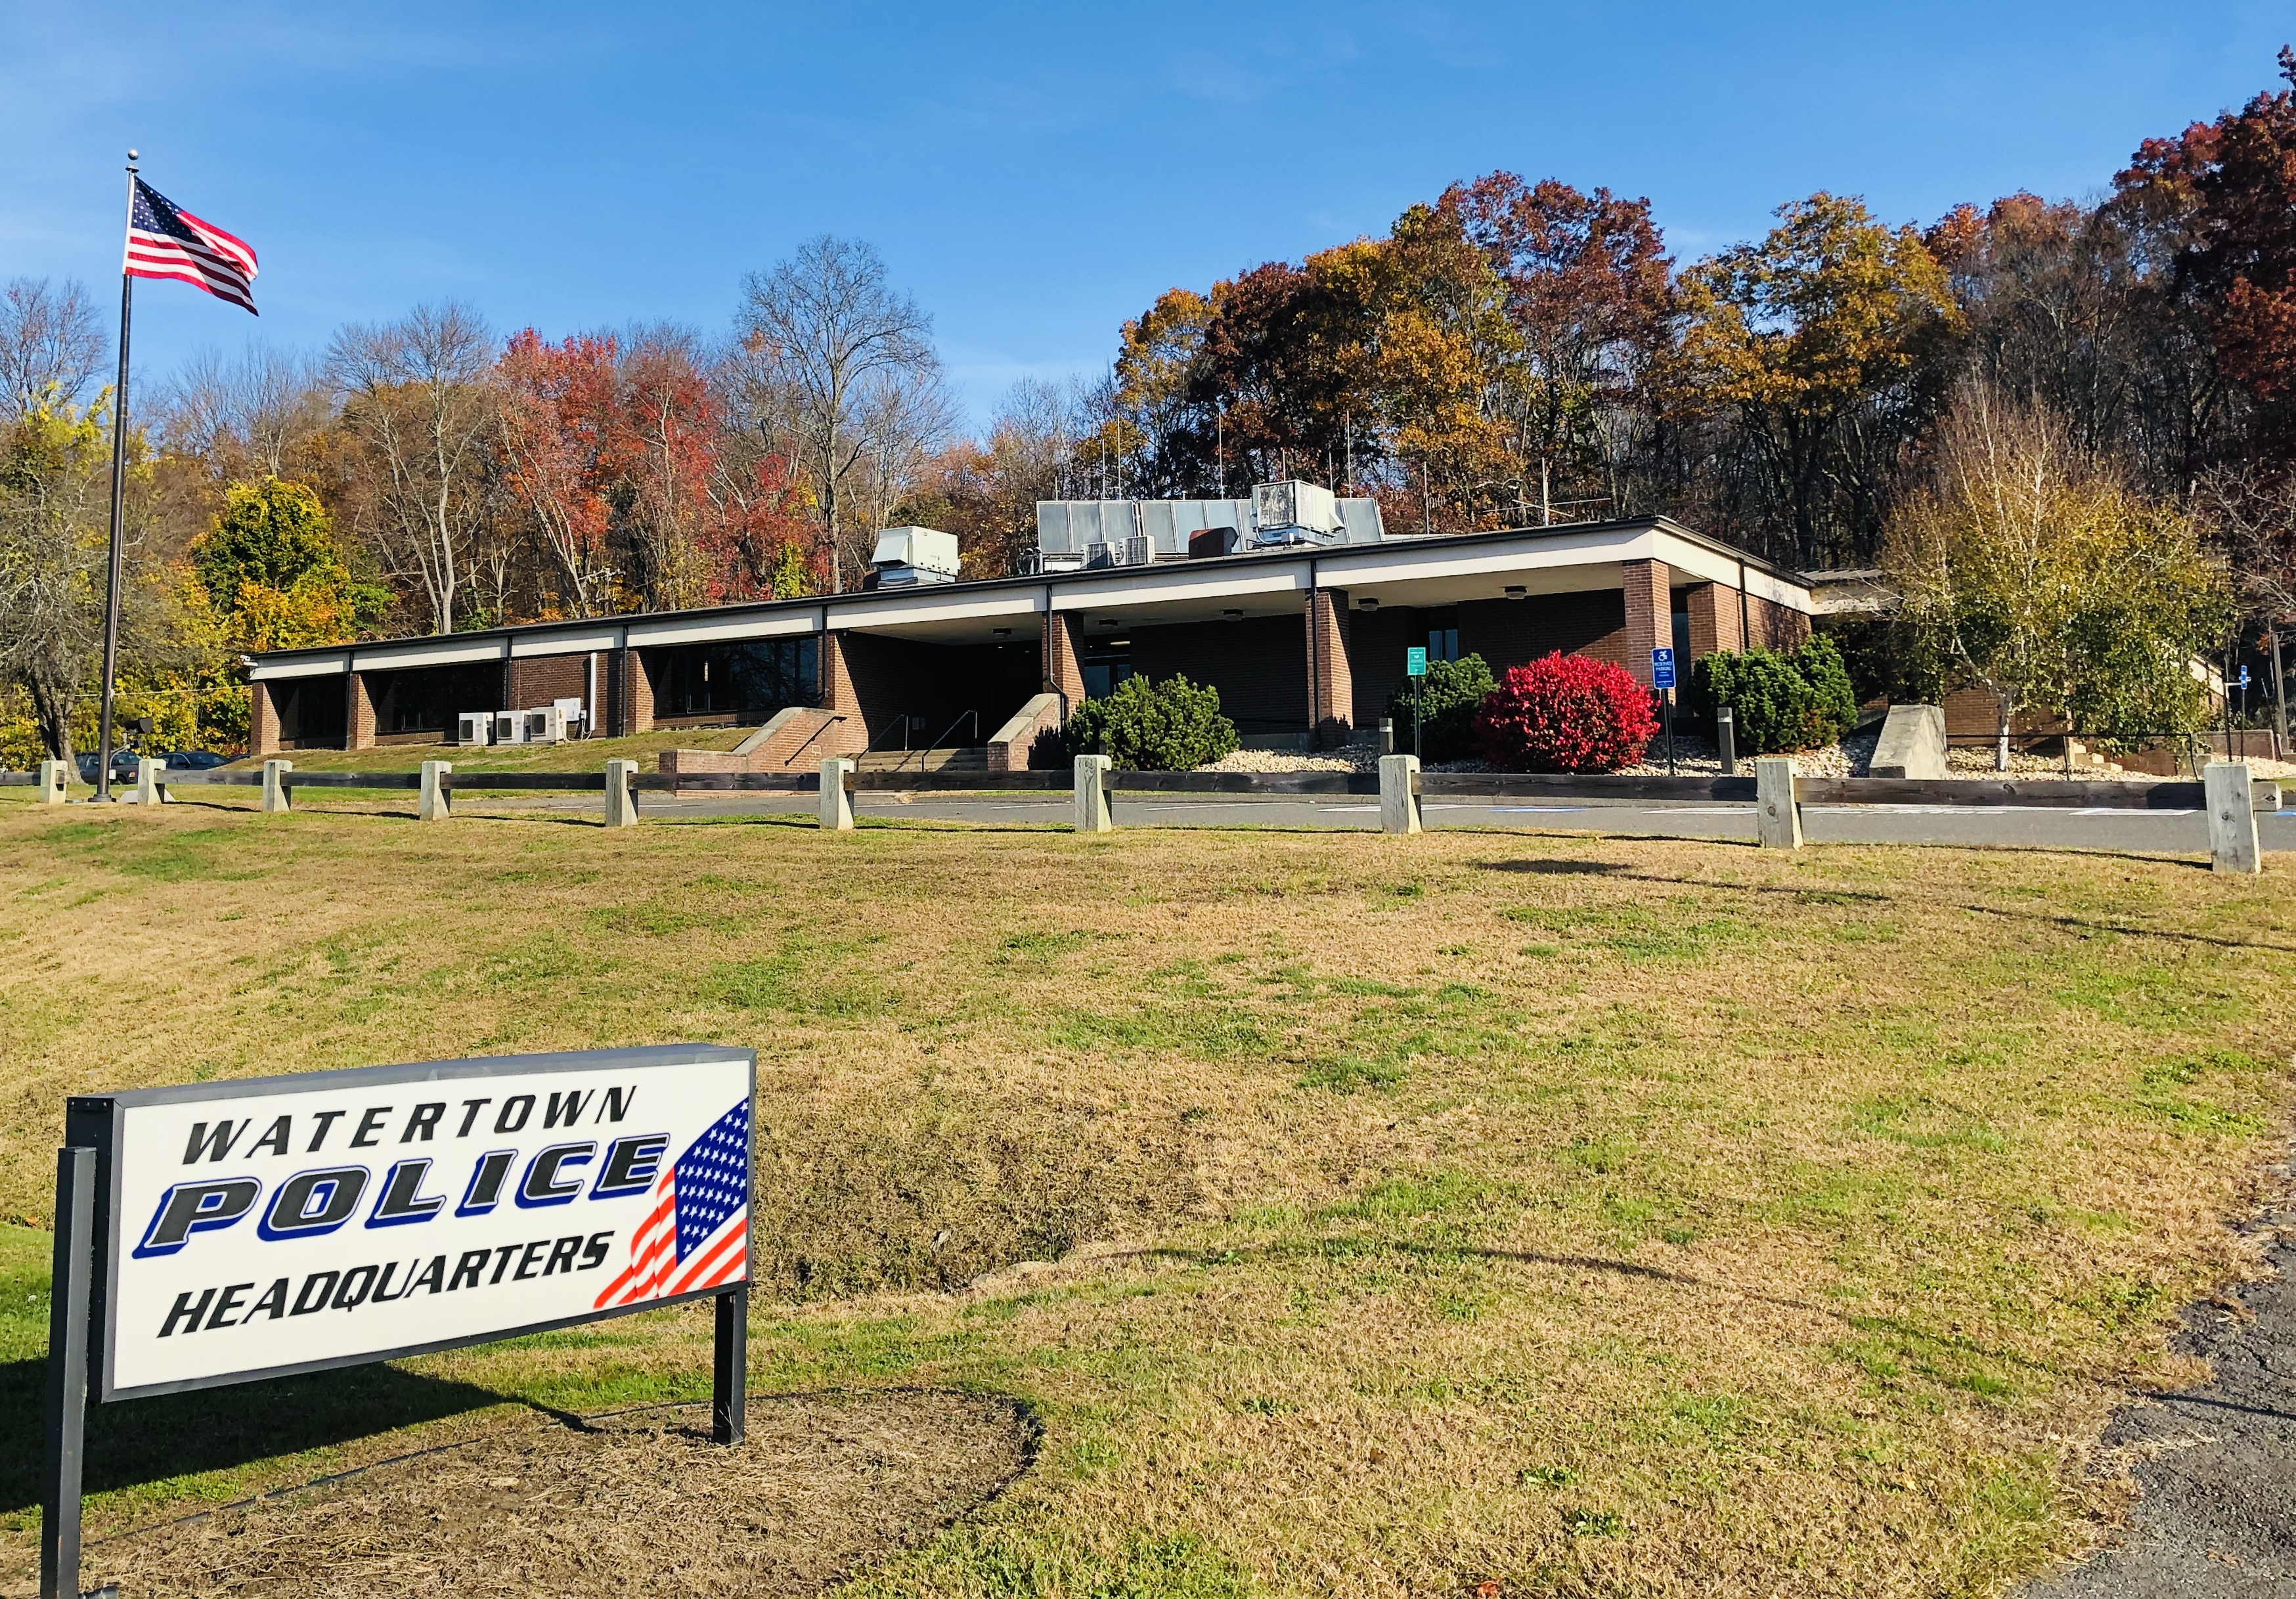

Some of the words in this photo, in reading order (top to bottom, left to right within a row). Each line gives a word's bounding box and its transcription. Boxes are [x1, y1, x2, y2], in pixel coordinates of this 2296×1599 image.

[183, 1085, 637, 1165] WATERTOWN
[131, 1133, 671, 1259] POLICE
[156, 1231, 615, 1338] HEADQUARTERS
